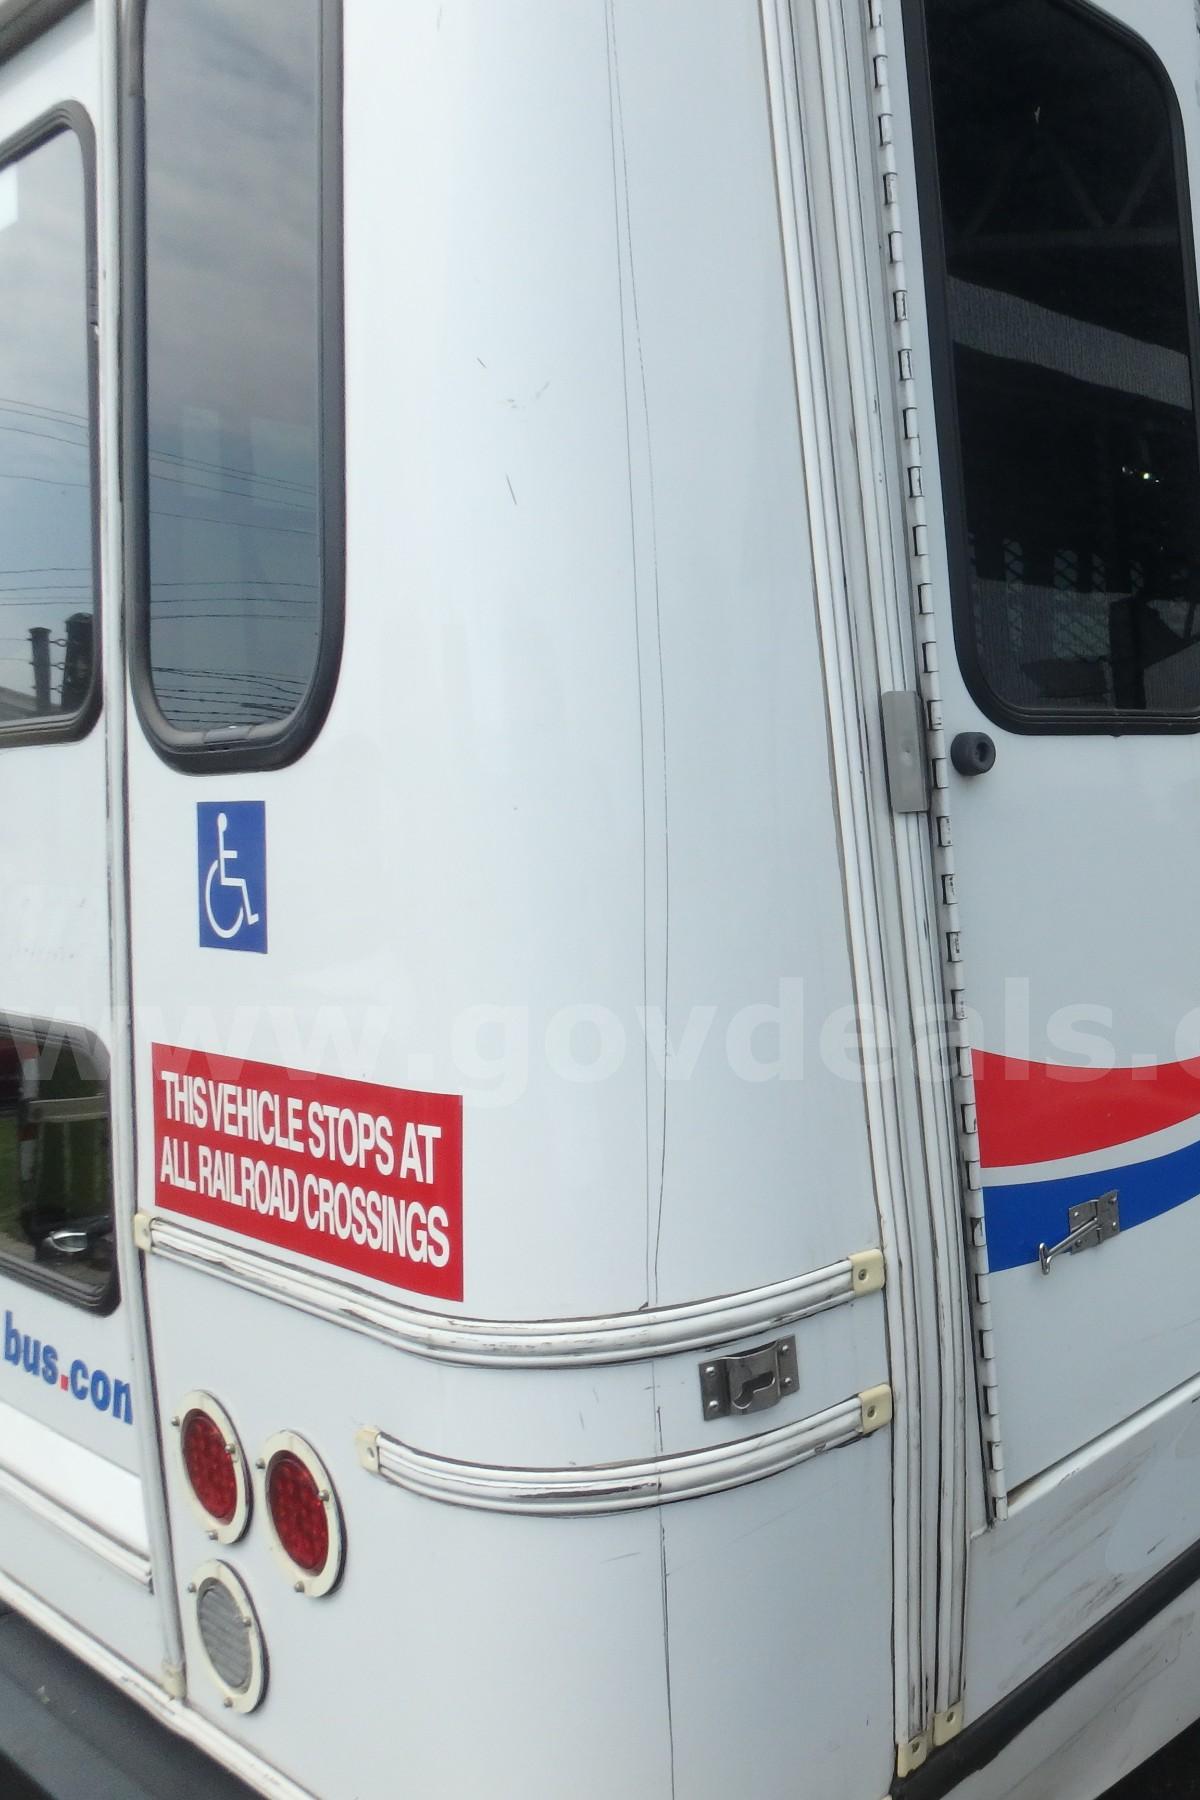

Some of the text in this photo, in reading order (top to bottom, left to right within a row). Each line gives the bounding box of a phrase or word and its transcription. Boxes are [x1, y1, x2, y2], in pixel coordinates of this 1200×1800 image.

[161, 1071, 441, 1184] THIS VEHICLE STOPS AT
[160, 1136, 450, 1267] ALL RAILROAD CROSSINGS
